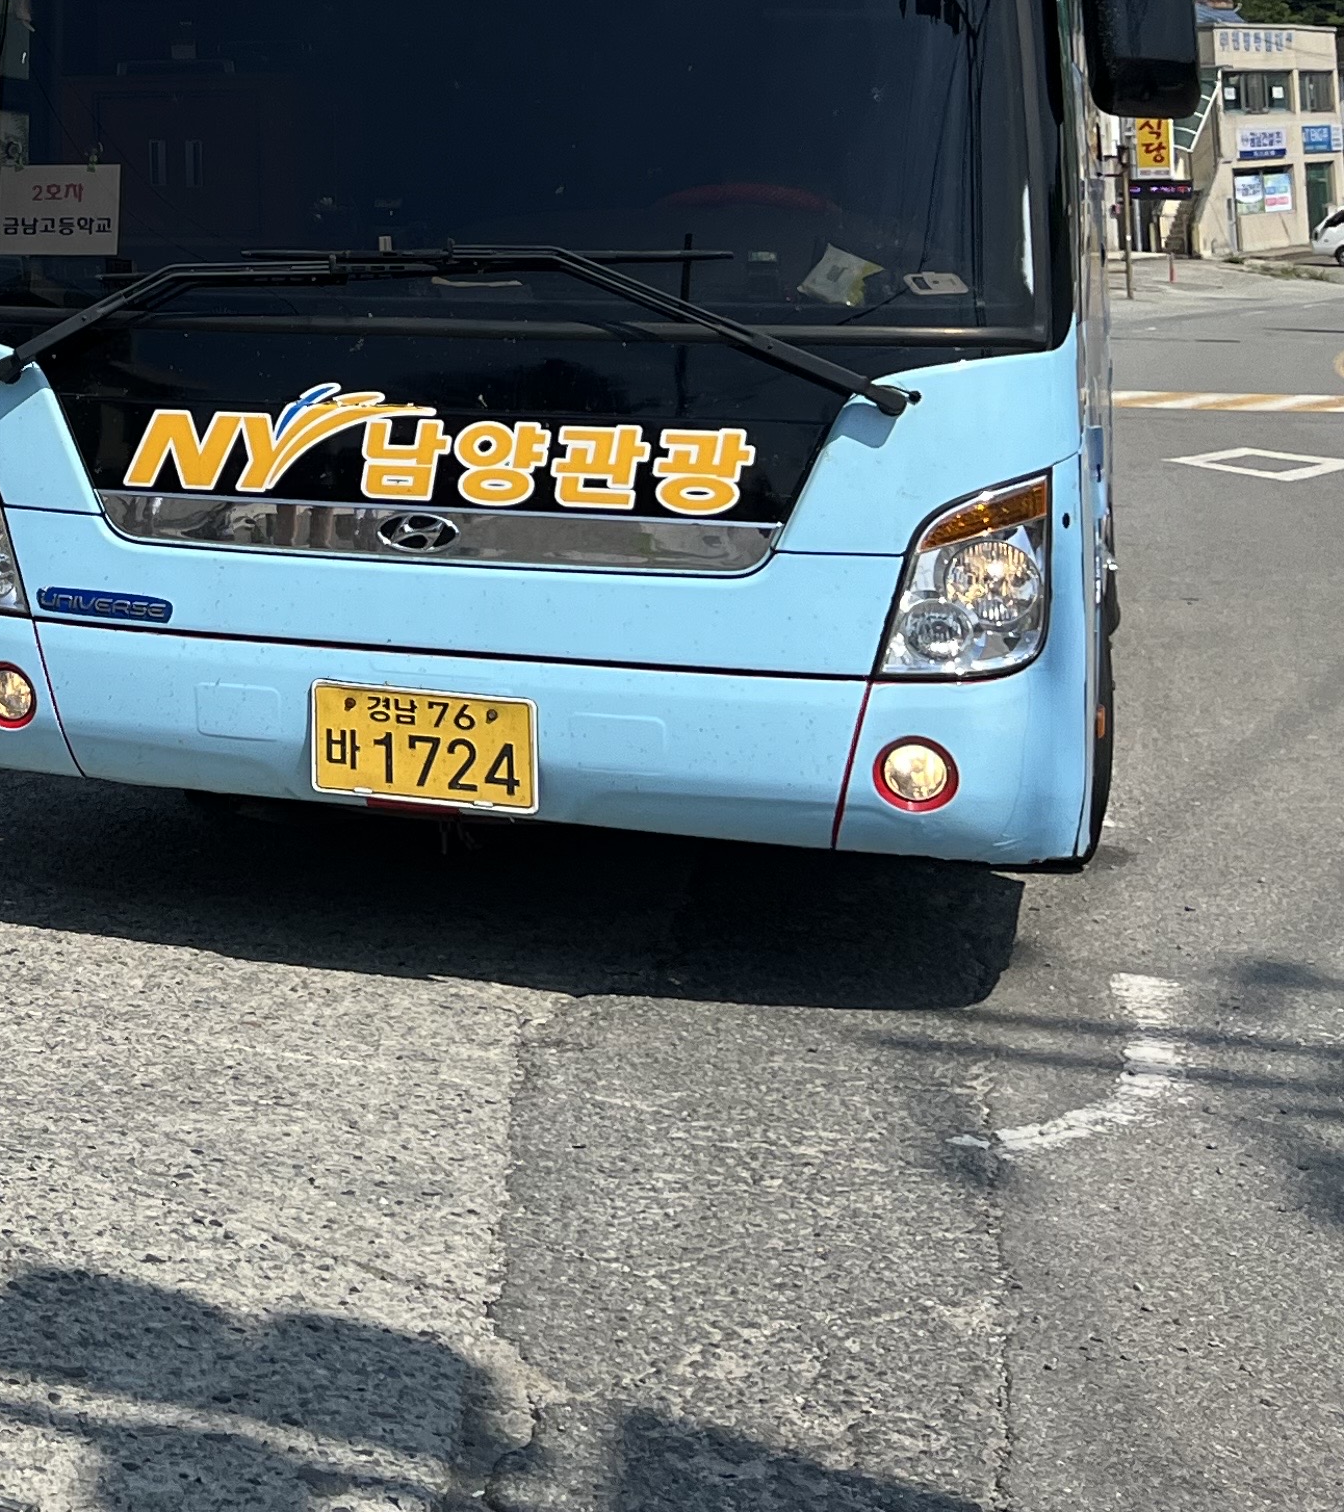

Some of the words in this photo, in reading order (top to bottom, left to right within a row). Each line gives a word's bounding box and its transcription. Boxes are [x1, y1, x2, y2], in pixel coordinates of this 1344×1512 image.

[3, 216, 112, 236] 금남고등학교
[360, 418, 754, 515] 남양관광
[41, 593, 166, 618] UNIVERSE
